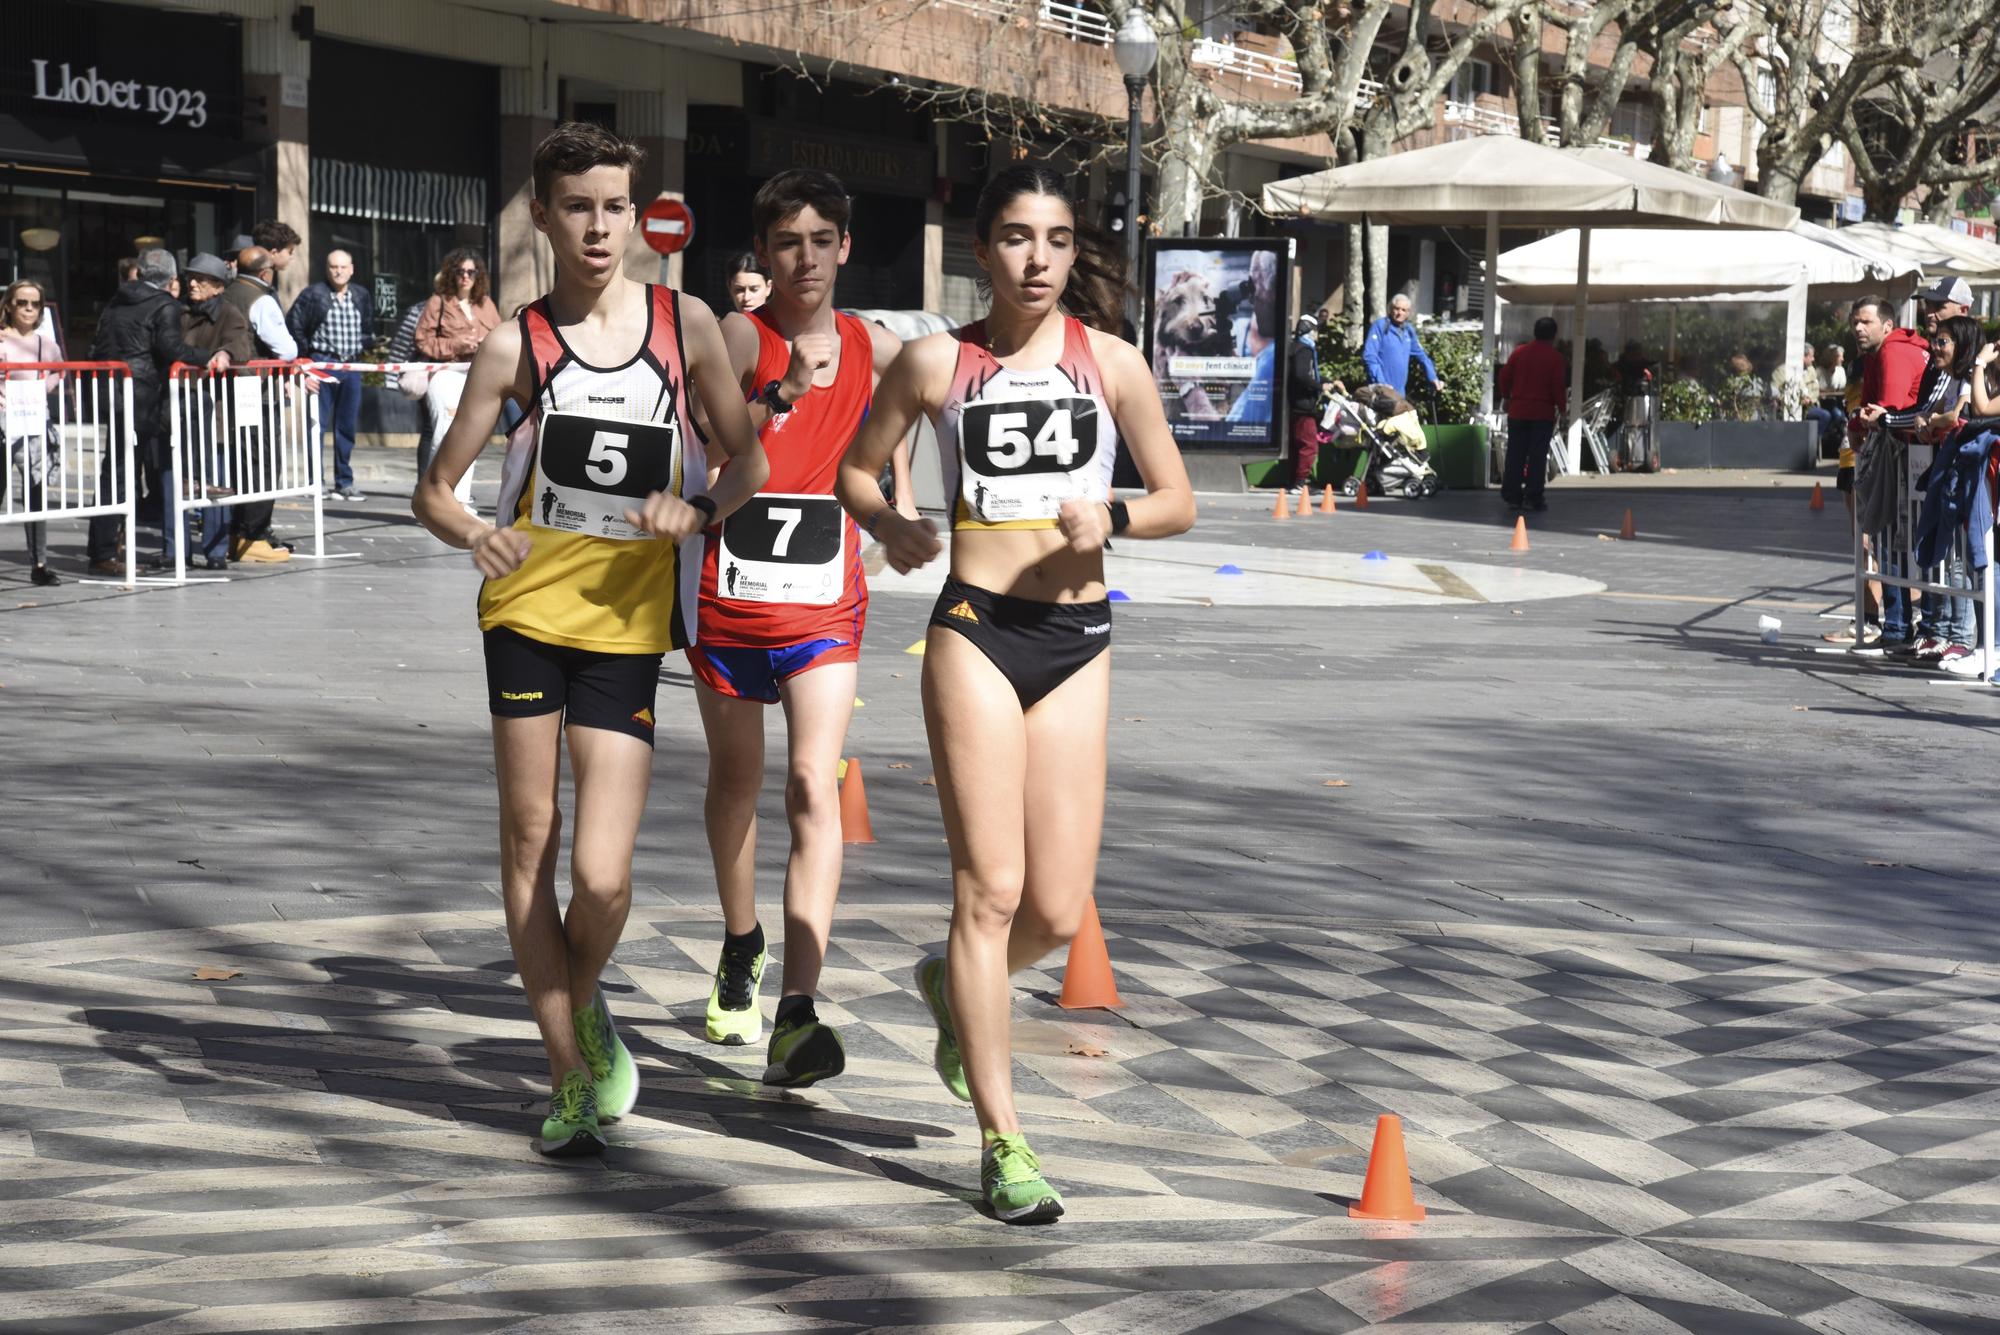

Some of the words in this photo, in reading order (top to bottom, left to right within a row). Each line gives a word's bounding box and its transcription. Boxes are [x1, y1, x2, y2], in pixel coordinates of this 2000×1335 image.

[32, 59, 141, 110] Llobet
[146, 85, 207, 128] 1923
[792, 140, 853, 174] ESTRADA
[585, 430, 629, 486] 5
[986, 409, 1079, 469] 54
[556, 508, 587, 519] MEMORIAL
[768, 507, 802, 557] 7
